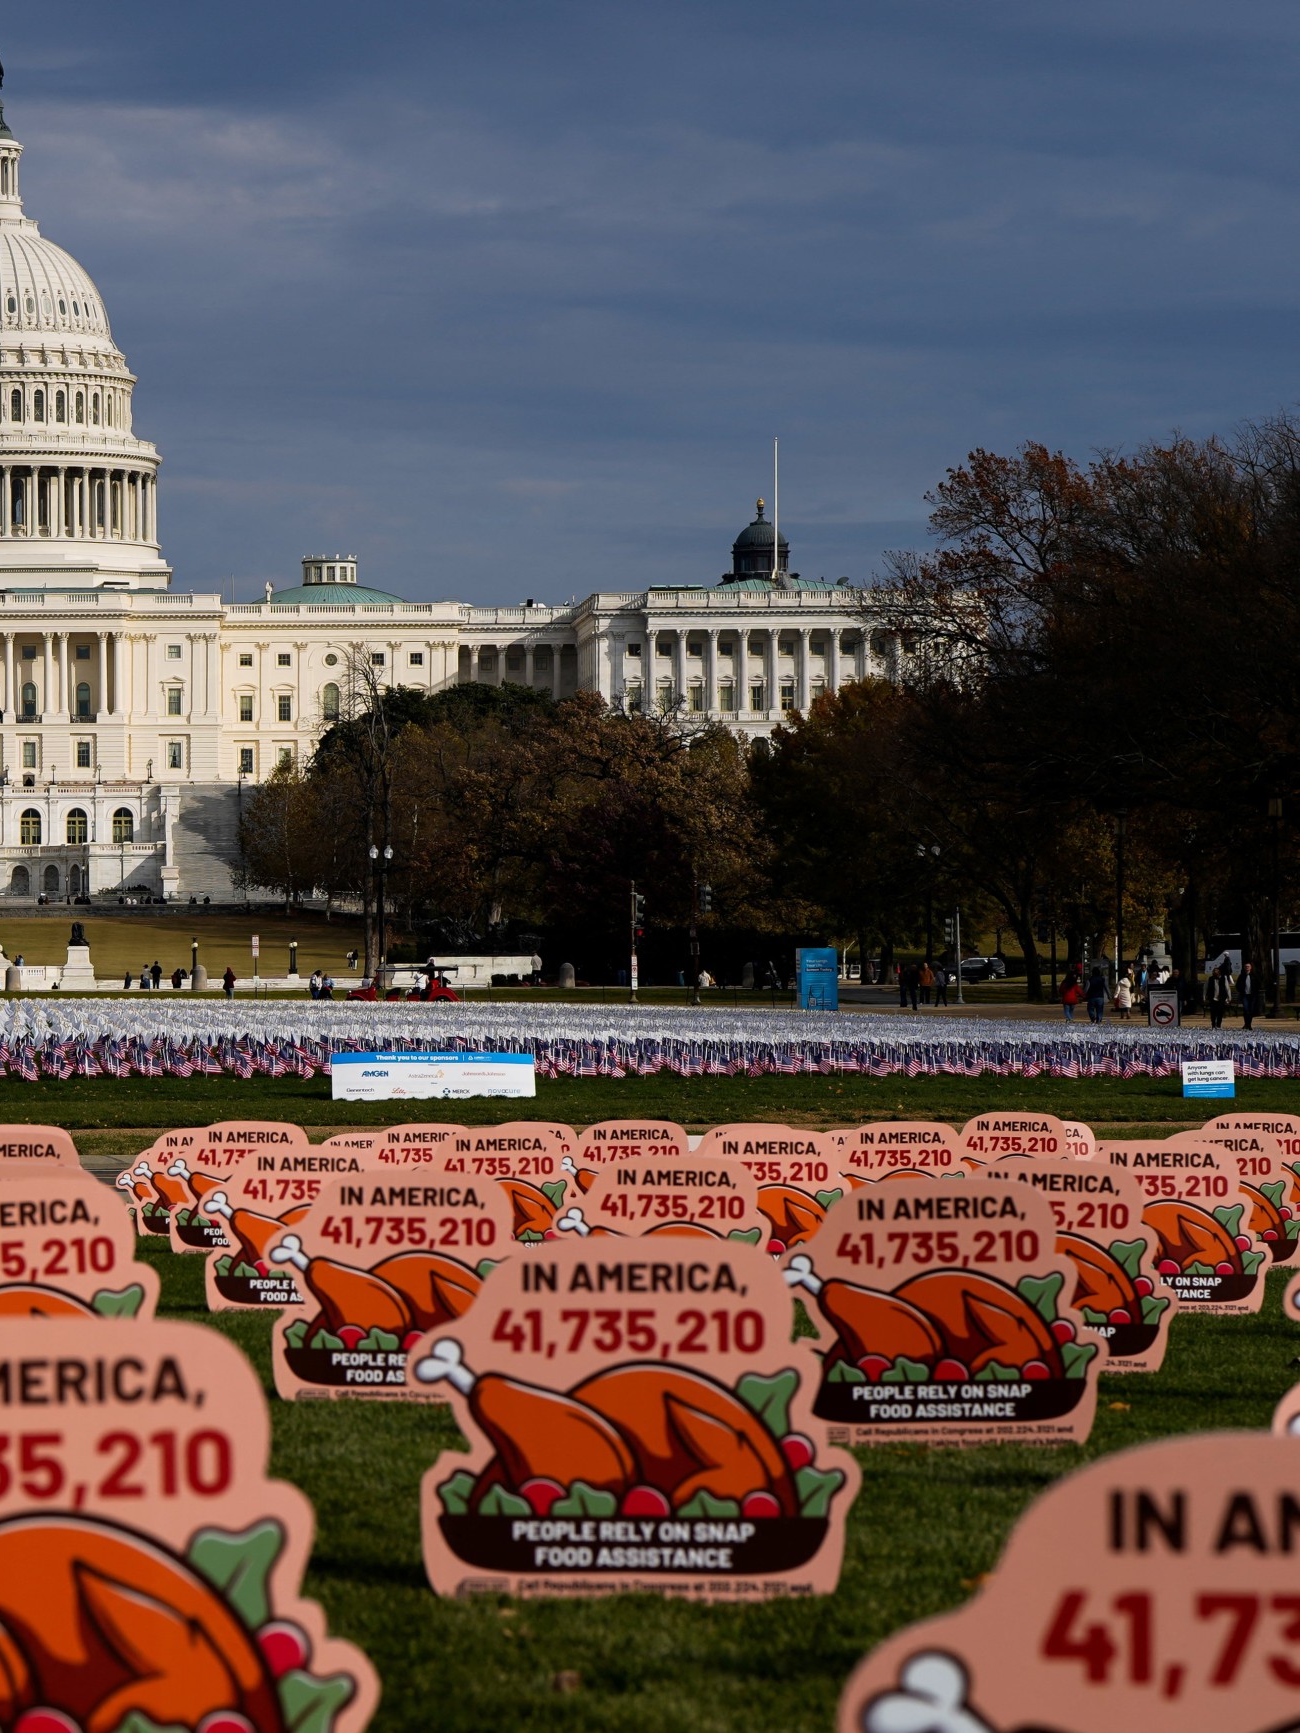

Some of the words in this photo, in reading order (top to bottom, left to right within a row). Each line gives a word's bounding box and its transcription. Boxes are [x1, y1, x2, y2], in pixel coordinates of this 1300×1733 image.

[977, 1121, 989, 1130] IN
[993, 1121, 1052, 1133] AMERICA,
[167, 1137, 177, 1146] IN
[209, 1132, 222, 1142] IN
[226, 1132, 293, 1144] AMERICA,
[388, 1133, 399, 1143] IN
[594, 1130, 606, 1140] IN
[610, 1129, 673, 1141] AMERICA,
[861, 1133, 874, 1144] IN
[878, 1132, 945, 1144] AMERICA,
[456, 1140, 470, 1151] IN
[475, 1138, 546, 1152] AMERICA,
[723, 1141, 738, 1154] IN
[743, 1141, 820, 1156] AMERICA,
[967, 1136, 1057, 1153] 41,735,210
[258, 1157, 274, 1171] IN
[849, 1149, 951, 1169] 41,735,210
[1110, 1153, 1127, 1167] IN
[1133, 1153, 1219, 1170] AMERICA,
[618, 1169, 636, 1185] IN
[642, 1170, 736, 1189] AMERICA,
[341, 1187, 363, 1205] IN
[370, 1187, 485, 1209] AMERICA,
[601, 1194, 744, 1220] 41,735,210
[858, 1199, 884, 1220] IN
[893, 1196, 1025, 1220] AMERICA,
[321, 1216, 496, 1251] 41,735,210
[837, 1230, 1039, 1270] 41,735,210
[250, 1280, 289, 1289] PEOPLE
[523, 1264, 557, 1292] IN
[569, 1263, 747, 1296] AMERICA,
[1176, 1277, 1190, 1286] ON
[1193, 1277, 1222, 1286] SNAP
[261, 1292, 288, 1301] FOOD
[492, 1309, 765, 1360] 41,735,210
[332, 1353, 385, 1366] PEOPLE
[347, 1370, 383, 1382] FOOD
[853, 1386, 914, 1400] PEOPLE
[917, 1385, 957, 1399] RELY
[961, 1385, 983, 1398] ON
[987, 1384, 1031, 1398] SNAP
[870, 1404, 912, 1418] FOOD
[916, 1403, 1015, 1417] ASSISTANCE
[1110, 1490, 1186, 1553] IN
[513, 1521, 595, 1541] PEOPLE
[600, 1522, 654, 1541] RELY
[659, 1523, 689, 1541] ON
[694, 1523, 755, 1542] SNAP
[536, 1547, 592, 1566] FOOD
[597, 1547, 731, 1568] ASSISTANCE
